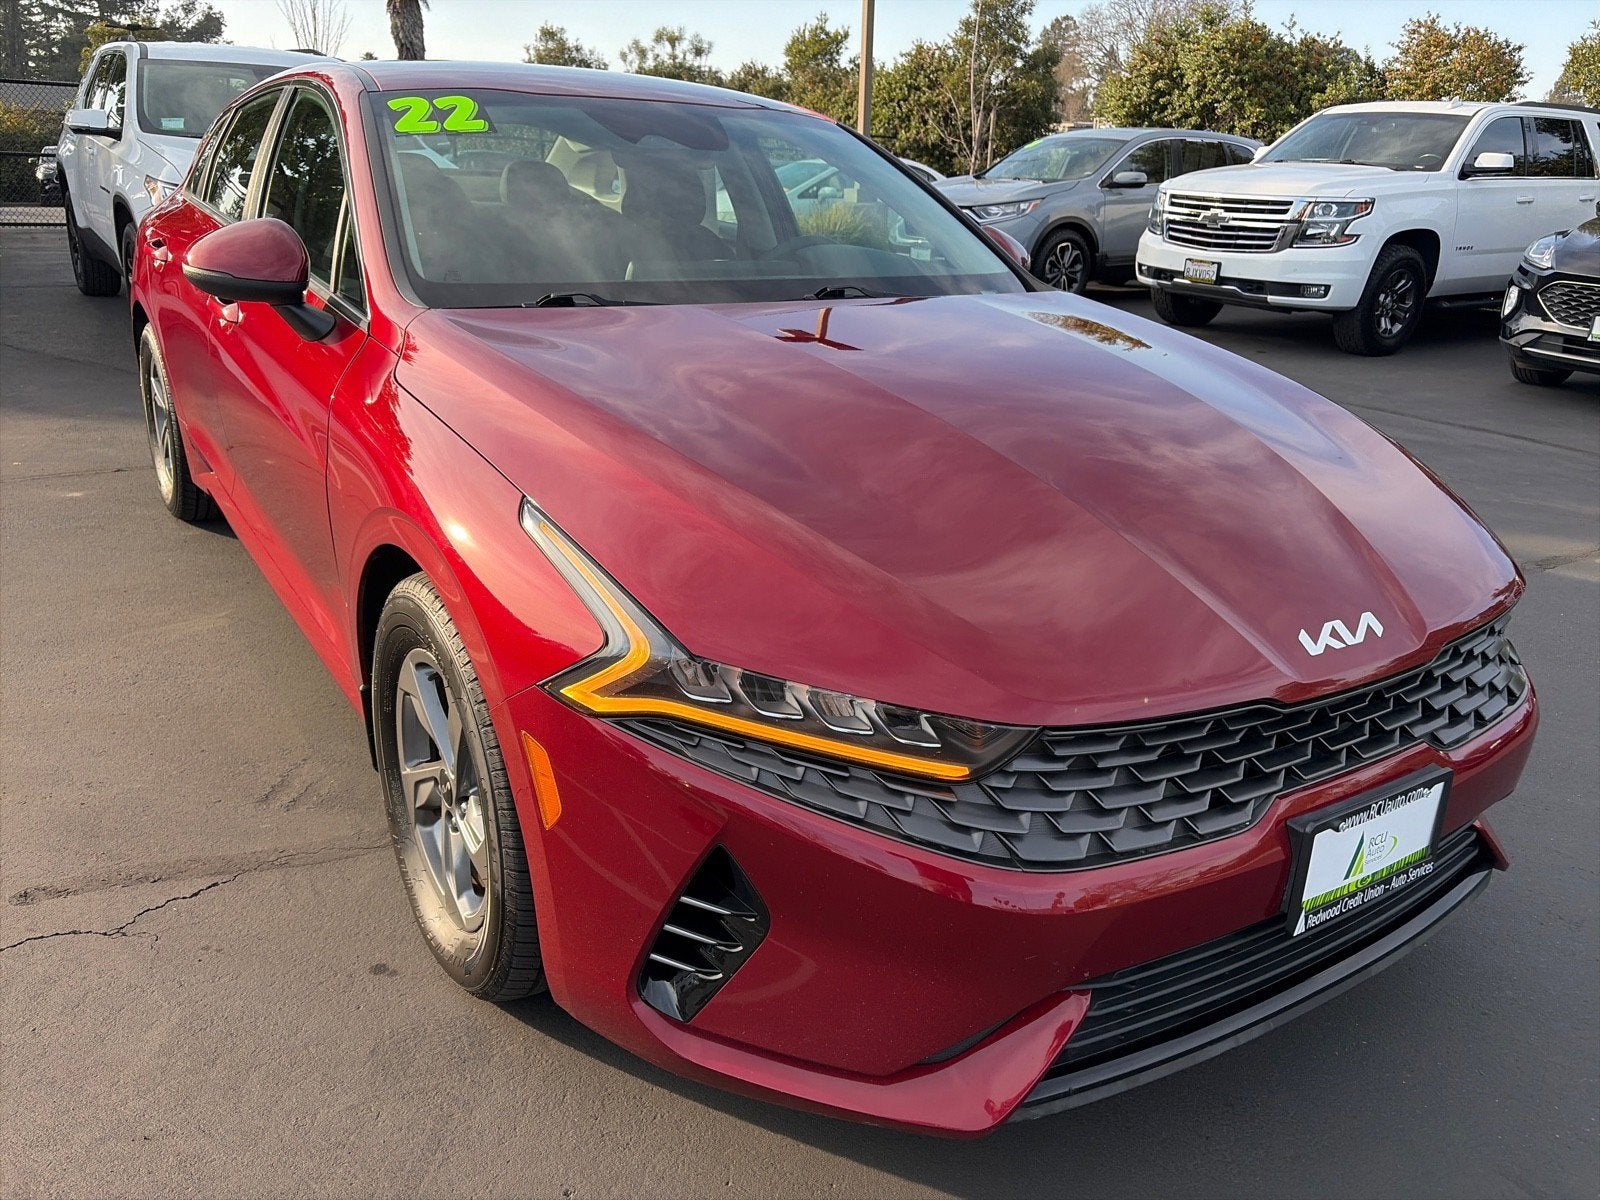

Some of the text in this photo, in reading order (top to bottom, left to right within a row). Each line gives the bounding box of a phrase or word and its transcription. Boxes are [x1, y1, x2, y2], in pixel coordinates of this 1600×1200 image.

[387, 95, 489, 134] 22
[1298, 611, 1384, 656] KIA
[1346, 787, 1425, 828] www.RCUauto.com
[1368, 831, 1388, 849] RCU
[1306, 901, 1342, 929] Redwood
[1341, 892, 1364, 913] Credit
[1363, 884, 1384, 903] Union
[1389, 874, 1407, 890] Auto
[1406, 861, 1434, 882] Services
